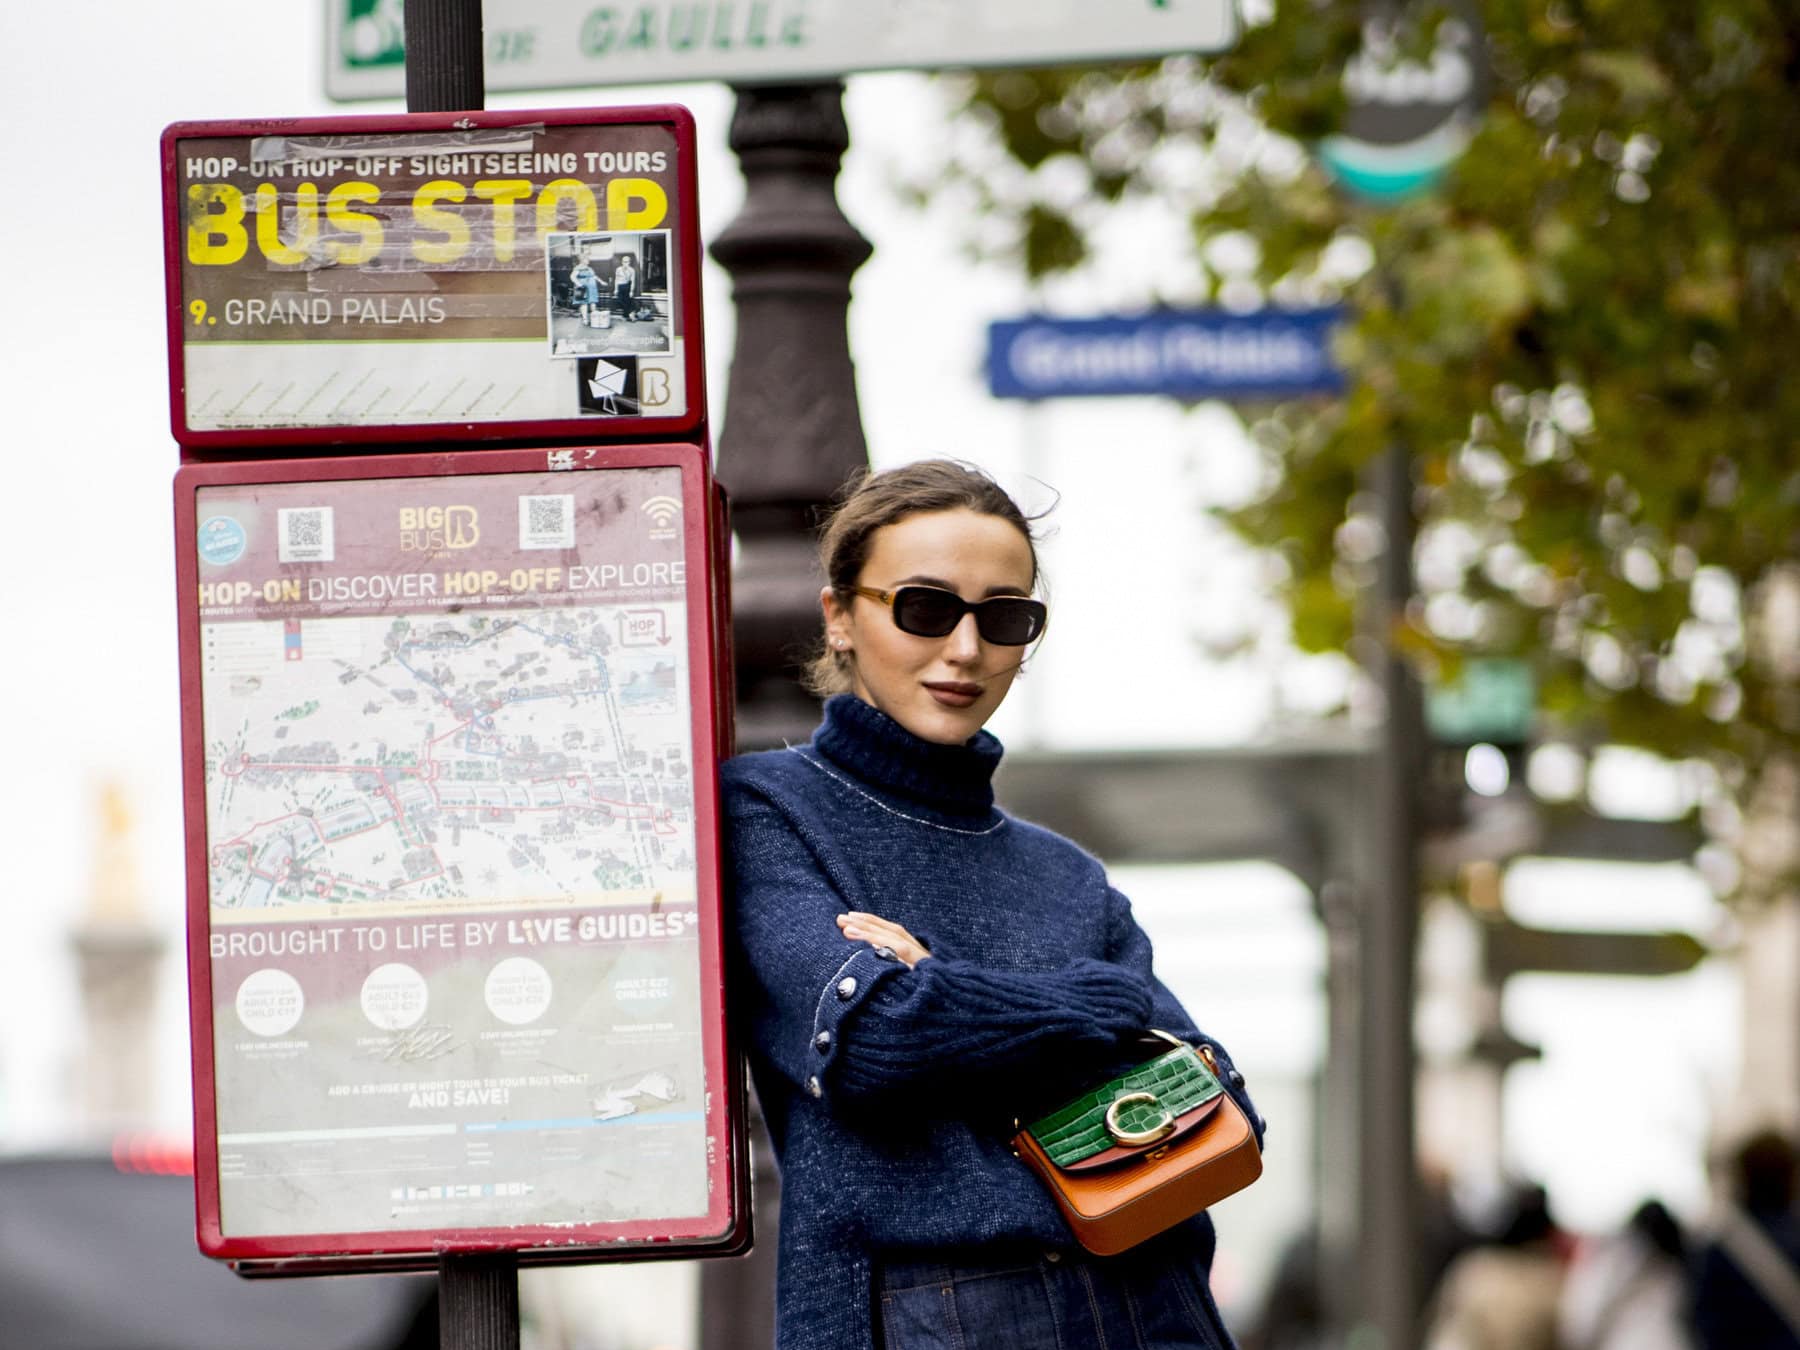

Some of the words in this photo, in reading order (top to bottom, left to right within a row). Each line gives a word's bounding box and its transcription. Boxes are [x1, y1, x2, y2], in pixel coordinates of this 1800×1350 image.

[186, 158, 284, 179] HOP-ON
[292, 156, 403, 178] HOP-OFF
[410, 152, 577, 176] SIGHTSEEING
[584, 151, 667, 173] TOURS
[187, 181, 385, 265] BUS
[411, 178, 668, 264] STOP
[189, 300, 217, 324] 9.
[224, 300, 332, 326] GRAND
[341, 297, 446, 324] PALAIS
[400, 507, 443, 530] BIG
[401, 527, 444, 551] BUS
[199, 578, 301, 606] HOP-ON
[309, 572, 437, 601] DISCOVER
[443, 567, 562, 595] HOP-OFF
[569, 560, 685, 589] EXPLORE
[629, 620, 655, 631] HOP
[210, 929, 344, 958] BROUGHT
[352, 927, 387, 951] TO
[396, 923, 455, 949] LIFE
[464, 921, 498, 946] BY
[408, 1091, 449, 1109] AND
[453, 1087, 510, 1107] SAVE!
